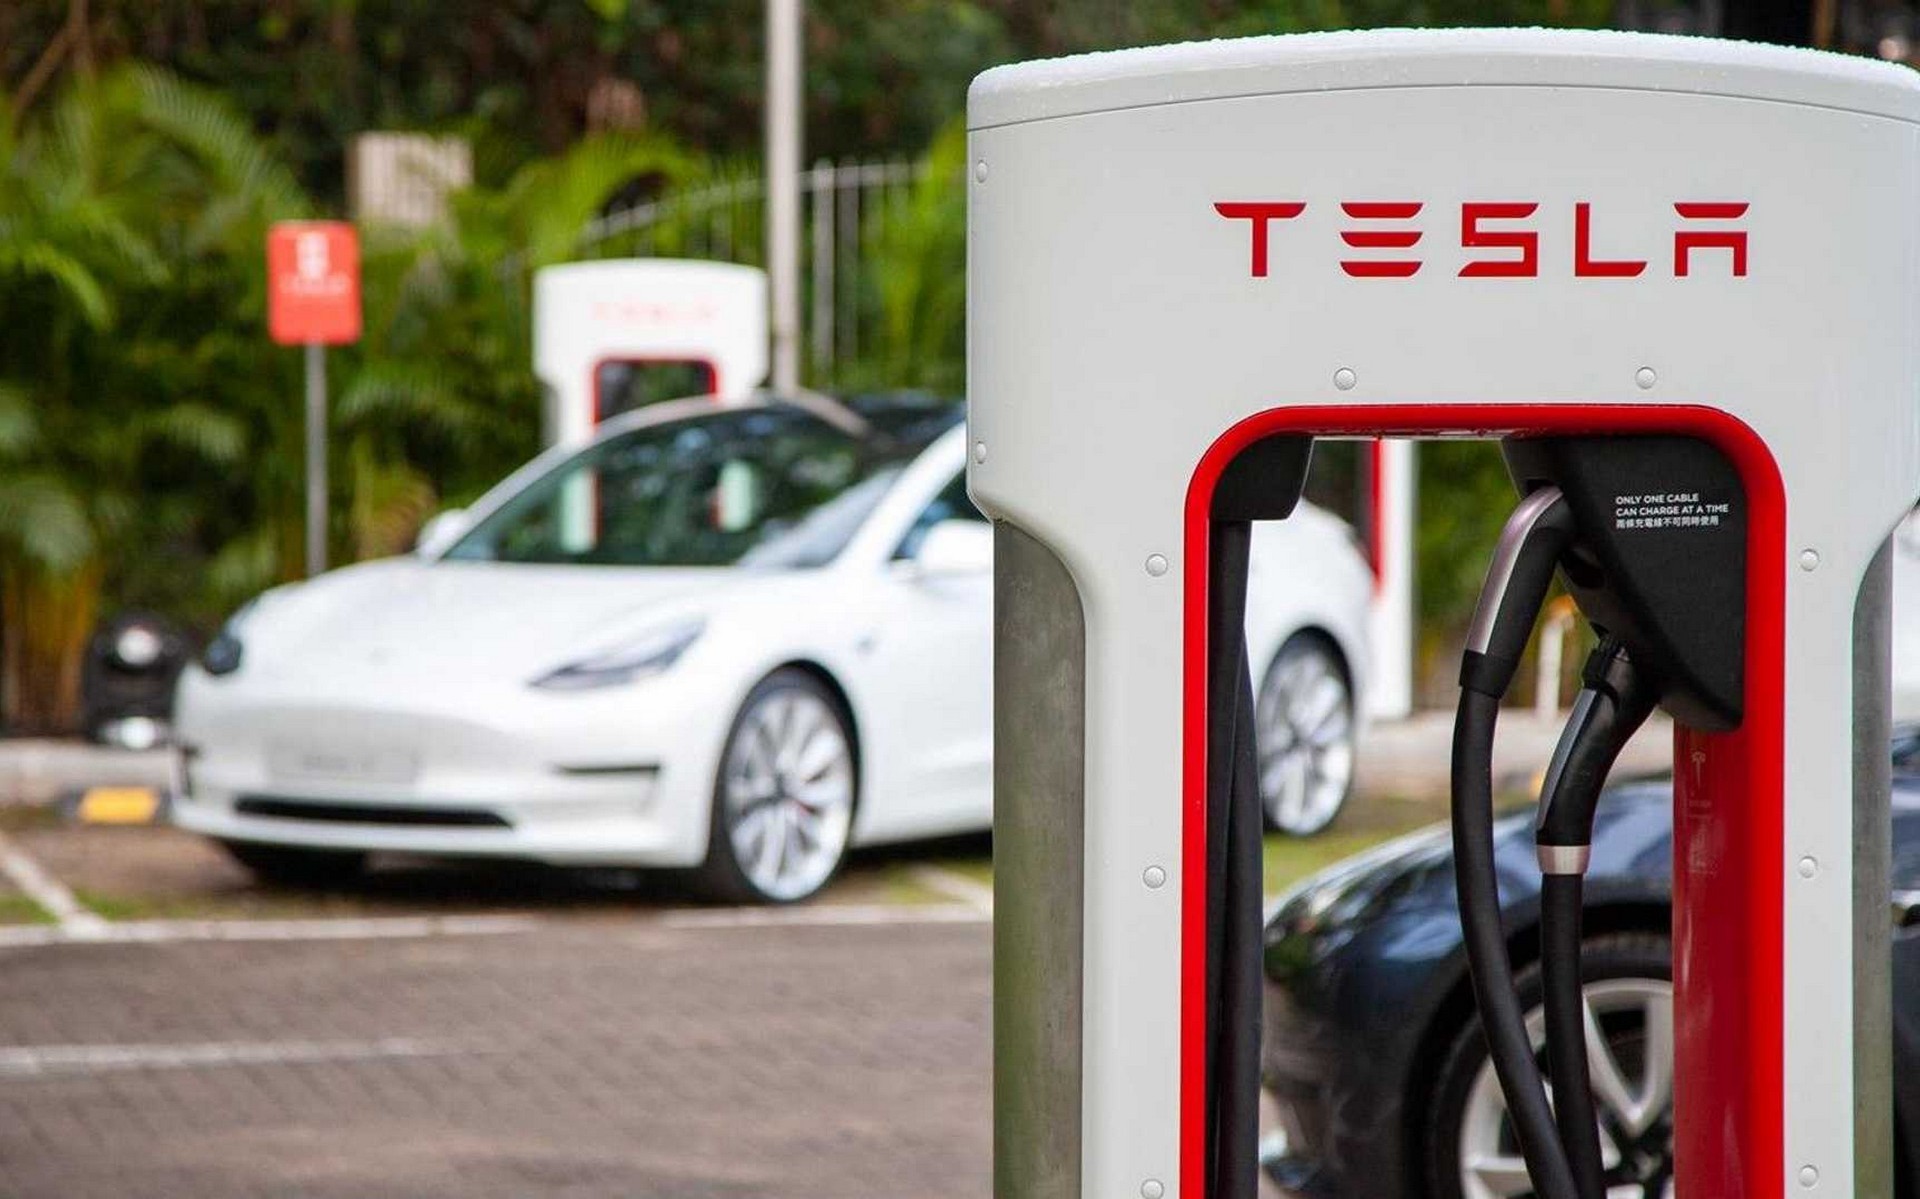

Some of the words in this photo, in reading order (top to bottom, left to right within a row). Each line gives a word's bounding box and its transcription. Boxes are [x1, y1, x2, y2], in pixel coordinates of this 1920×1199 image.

[1214, 202, 1750, 277] TESLA
[1616, 496, 1641, 504] ONLY
[1644, 495, 1665, 503] ONE
[1667, 493, 1699, 502] CABLE
[1616, 508, 1637, 516] CAN
[1639, 506, 1680, 515] CHARGE
[1681, 505, 1694, 514] AT
[1696, 505, 1704, 513] A
[1705, 504, 1729, 512] TIME
